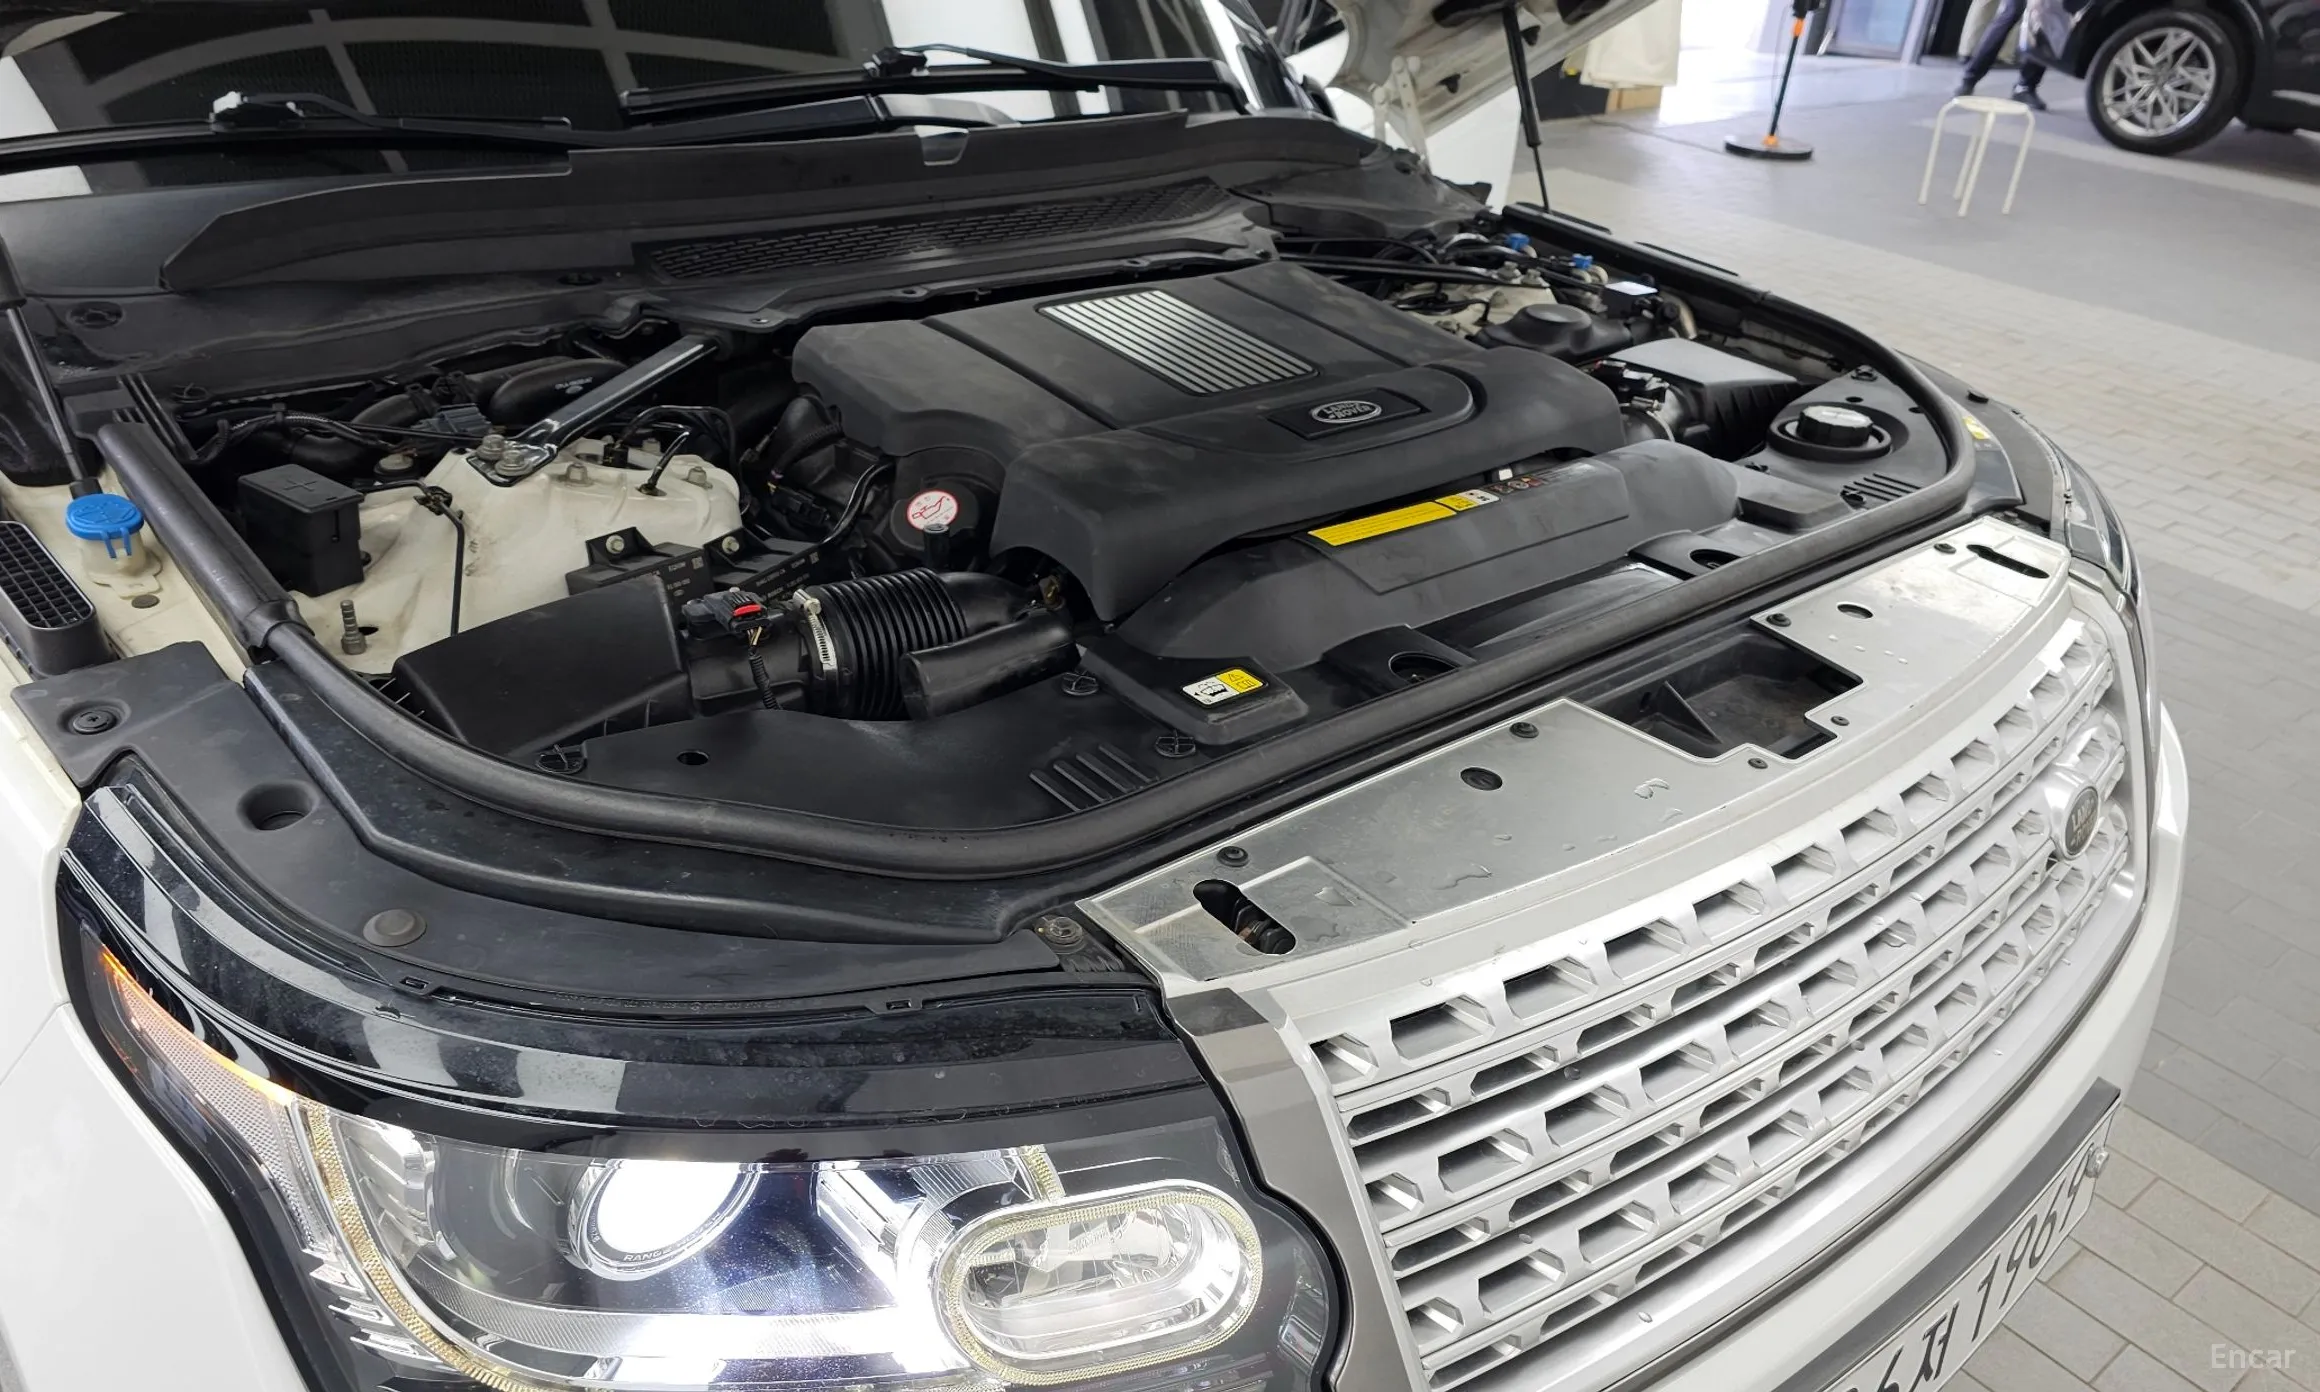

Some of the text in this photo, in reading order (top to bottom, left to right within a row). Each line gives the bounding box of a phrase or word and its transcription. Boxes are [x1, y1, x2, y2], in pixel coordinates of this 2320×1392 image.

[1322, 402, 1356, 414] LAND
[1335, 404, 1372, 419] ROVER
[1970, 1142, 2096, 1342] 1969
